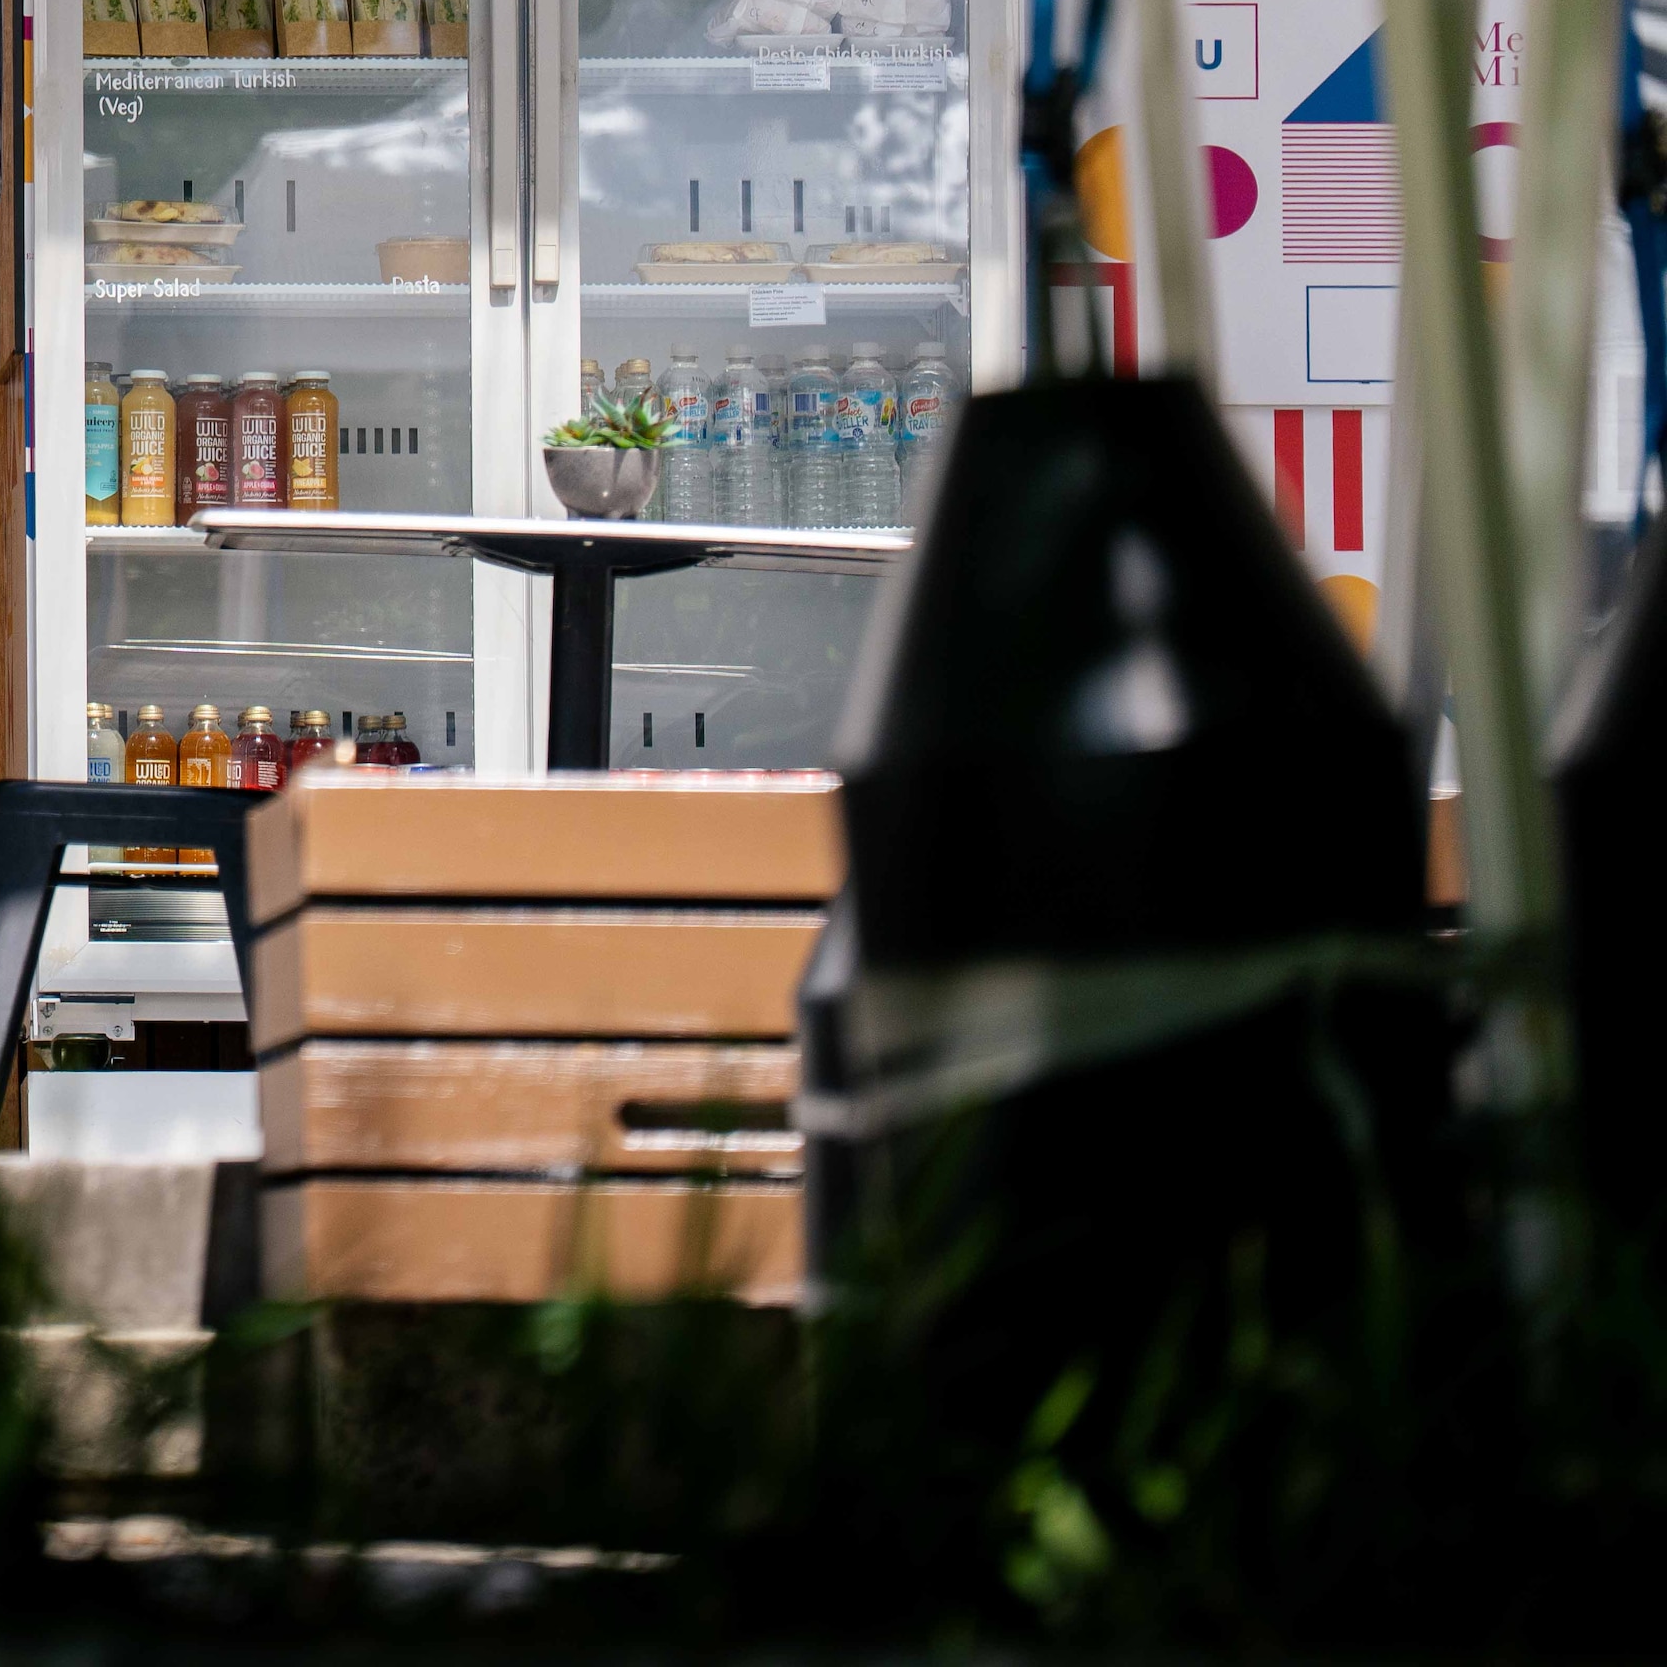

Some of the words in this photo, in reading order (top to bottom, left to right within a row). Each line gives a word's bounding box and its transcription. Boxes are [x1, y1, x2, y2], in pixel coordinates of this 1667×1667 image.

[1475, 22, 1524, 52] Me
[1195, 39, 1223, 70] U
[96, 72, 224, 91] Mediterranean
[233, 70, 296, 88] Turkish
[1472, 55, 1521, 86] Mi
[99, 96, 144, 122] (Veg)
[96, 279, 147, 302] Super
[153, 278, 200, 297] Salad
[392, 275, 440, 295] Pasta
[131, 414, 165, 431] WILD
[130, 431, 165, 440] ORGANIC
[131, 442, 165, 455] JUICE
